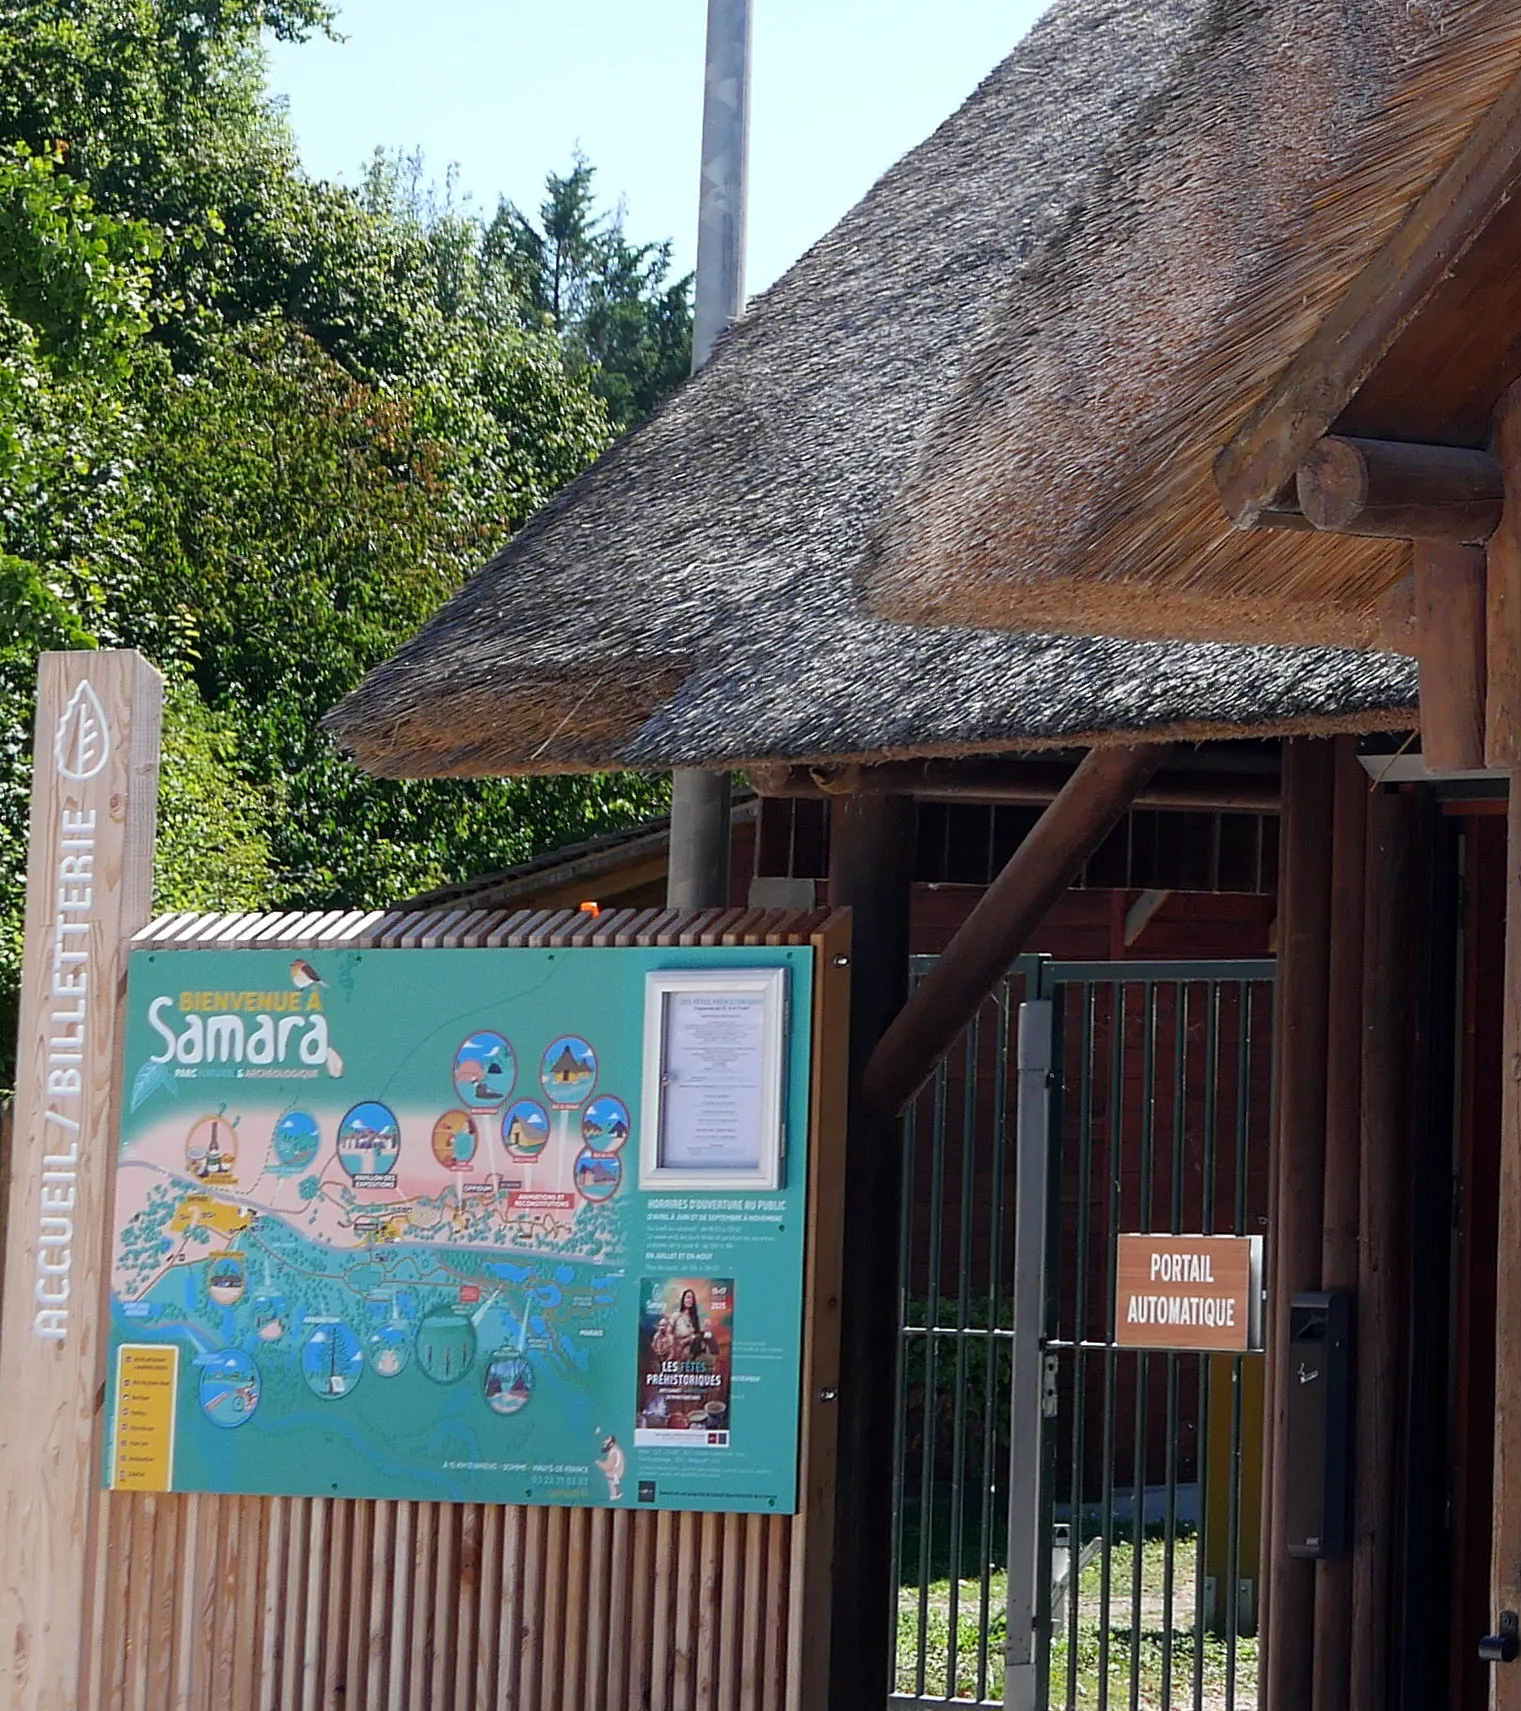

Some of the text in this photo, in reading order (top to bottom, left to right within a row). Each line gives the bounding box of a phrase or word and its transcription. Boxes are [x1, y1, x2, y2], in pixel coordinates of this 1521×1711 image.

[47, 808, 97, 1096] BILLETTERIE
[179, 991, 300, 1012] BIENVENUE
[148, 996, 328, 1065] Samara
[174, 1068, 198, 1078] PARC
[757, 1200, 786, 1211] PUBLIC
[32, 1142, 79, 1340] ACCUEIL
[1150, 1253, 1214, 1282] PORTAIL
[1127, 1295, 1236, 1327] AUTOMATIQUE
[646, 1372, 722, 1386] PRÉHISTORIQUES
[662, 1361, 678, 1372] LES
